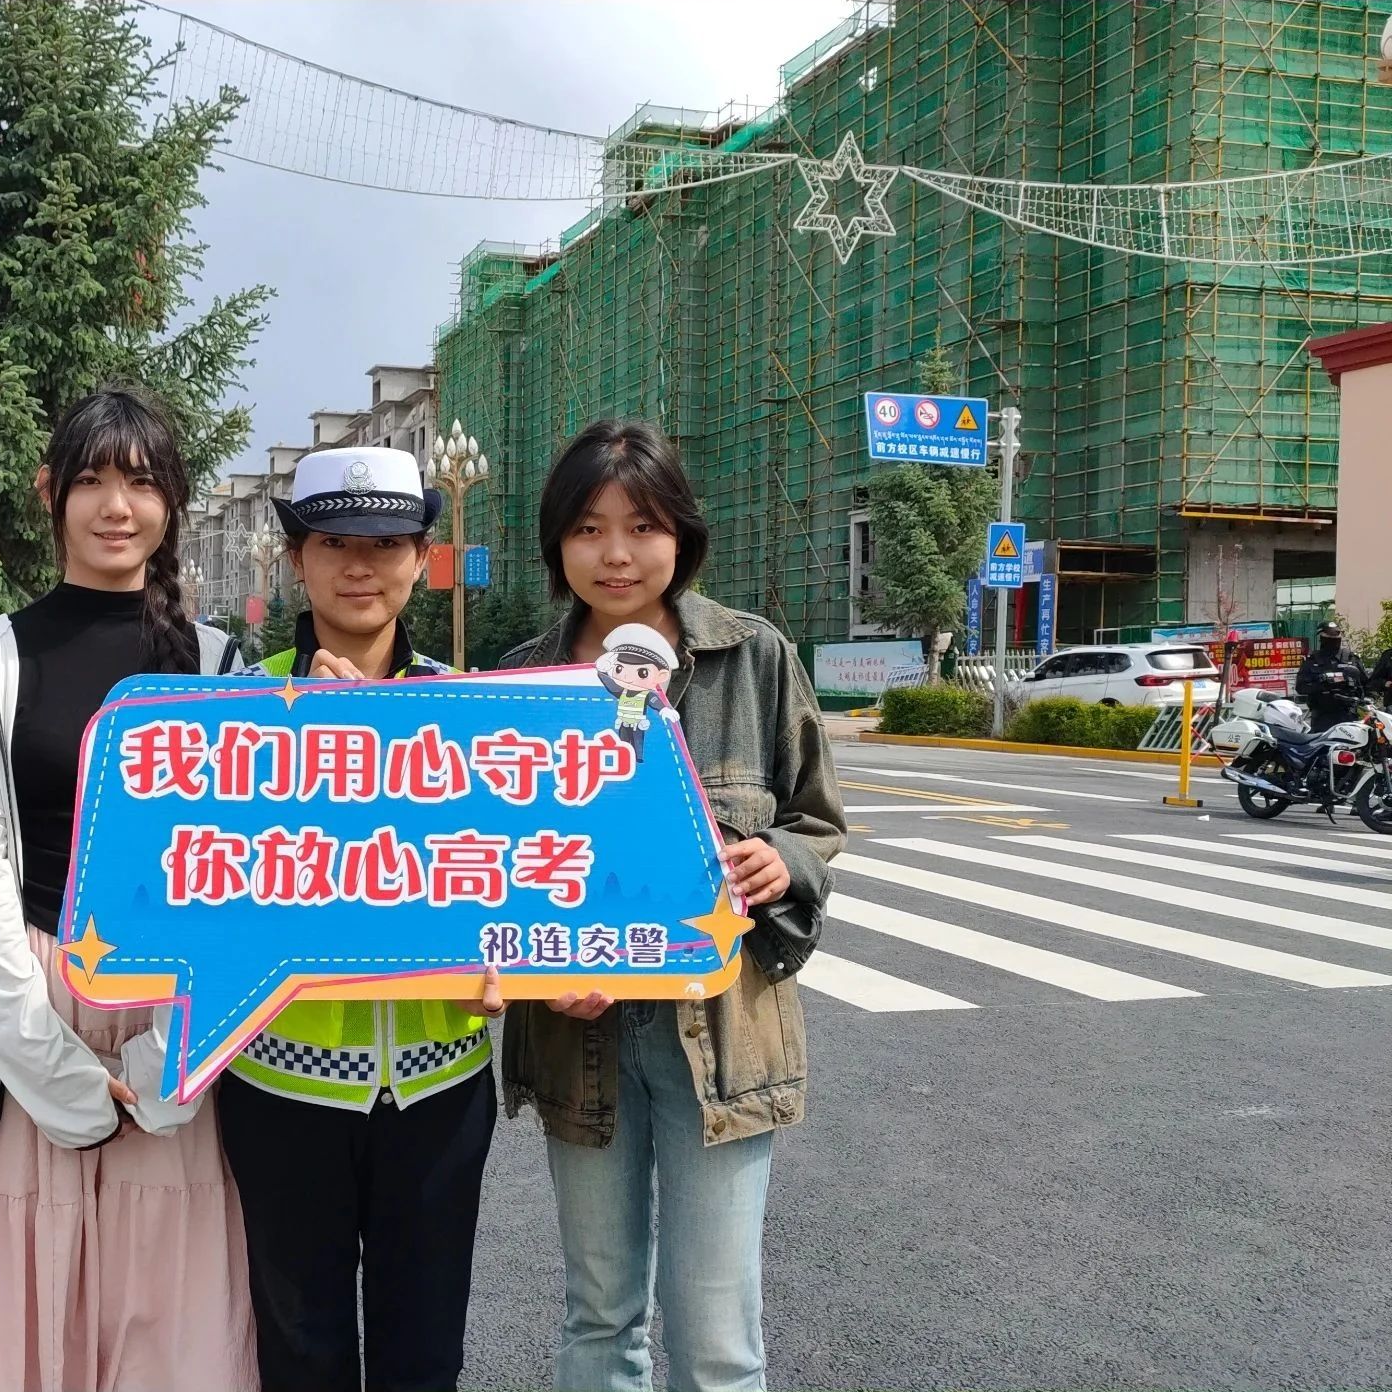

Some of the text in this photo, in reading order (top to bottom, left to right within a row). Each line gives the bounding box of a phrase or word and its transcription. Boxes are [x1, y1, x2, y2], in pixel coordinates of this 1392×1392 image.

[878, 405, 897, 419] 40
[876, 441, 982, 460] 前方校区车辆减速慢行
[990, 562, 1021, 572] 前方学校
[1245, 657, 1271, 668] 4900
[124, 724, 632, 803] 我们用心守护
[166, 827, 594, 906] 你放心高考
[482, 925, 667, 966] 祁连交警
